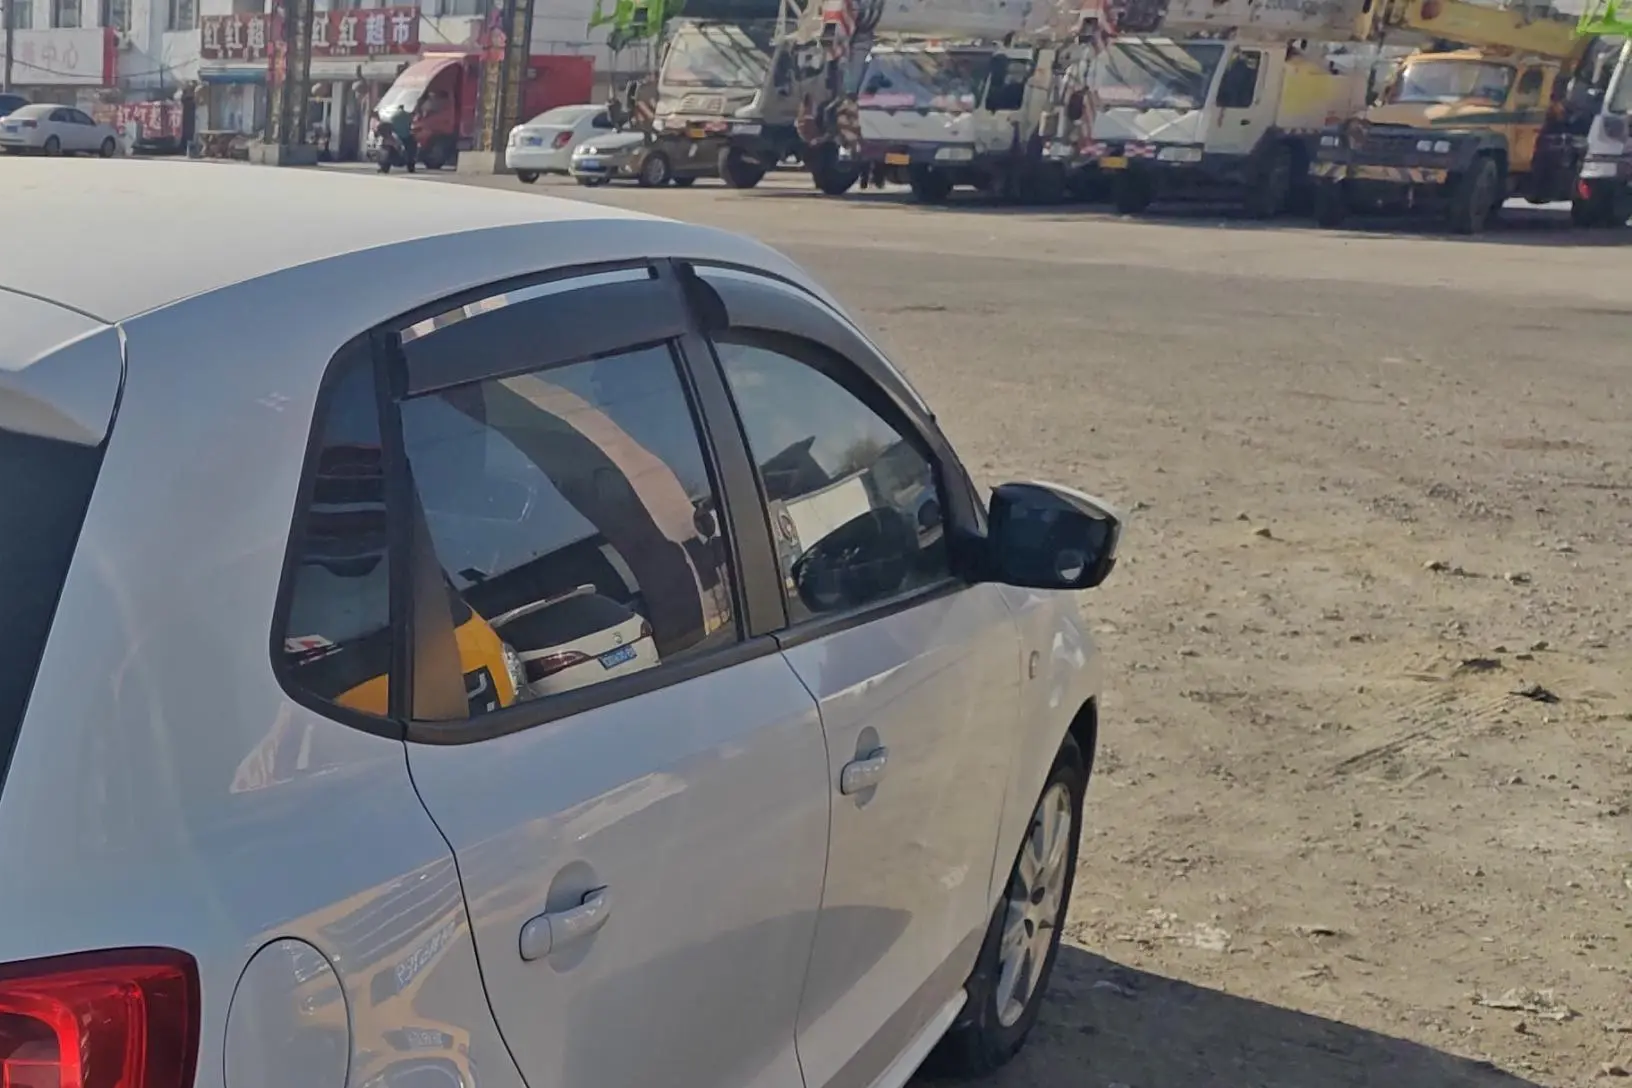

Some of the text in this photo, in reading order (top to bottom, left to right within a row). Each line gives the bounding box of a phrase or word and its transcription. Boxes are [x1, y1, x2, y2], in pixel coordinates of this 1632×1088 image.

[204, 16, 266, 49] 红红超
[311, 13, 411, 47] 红红超市
